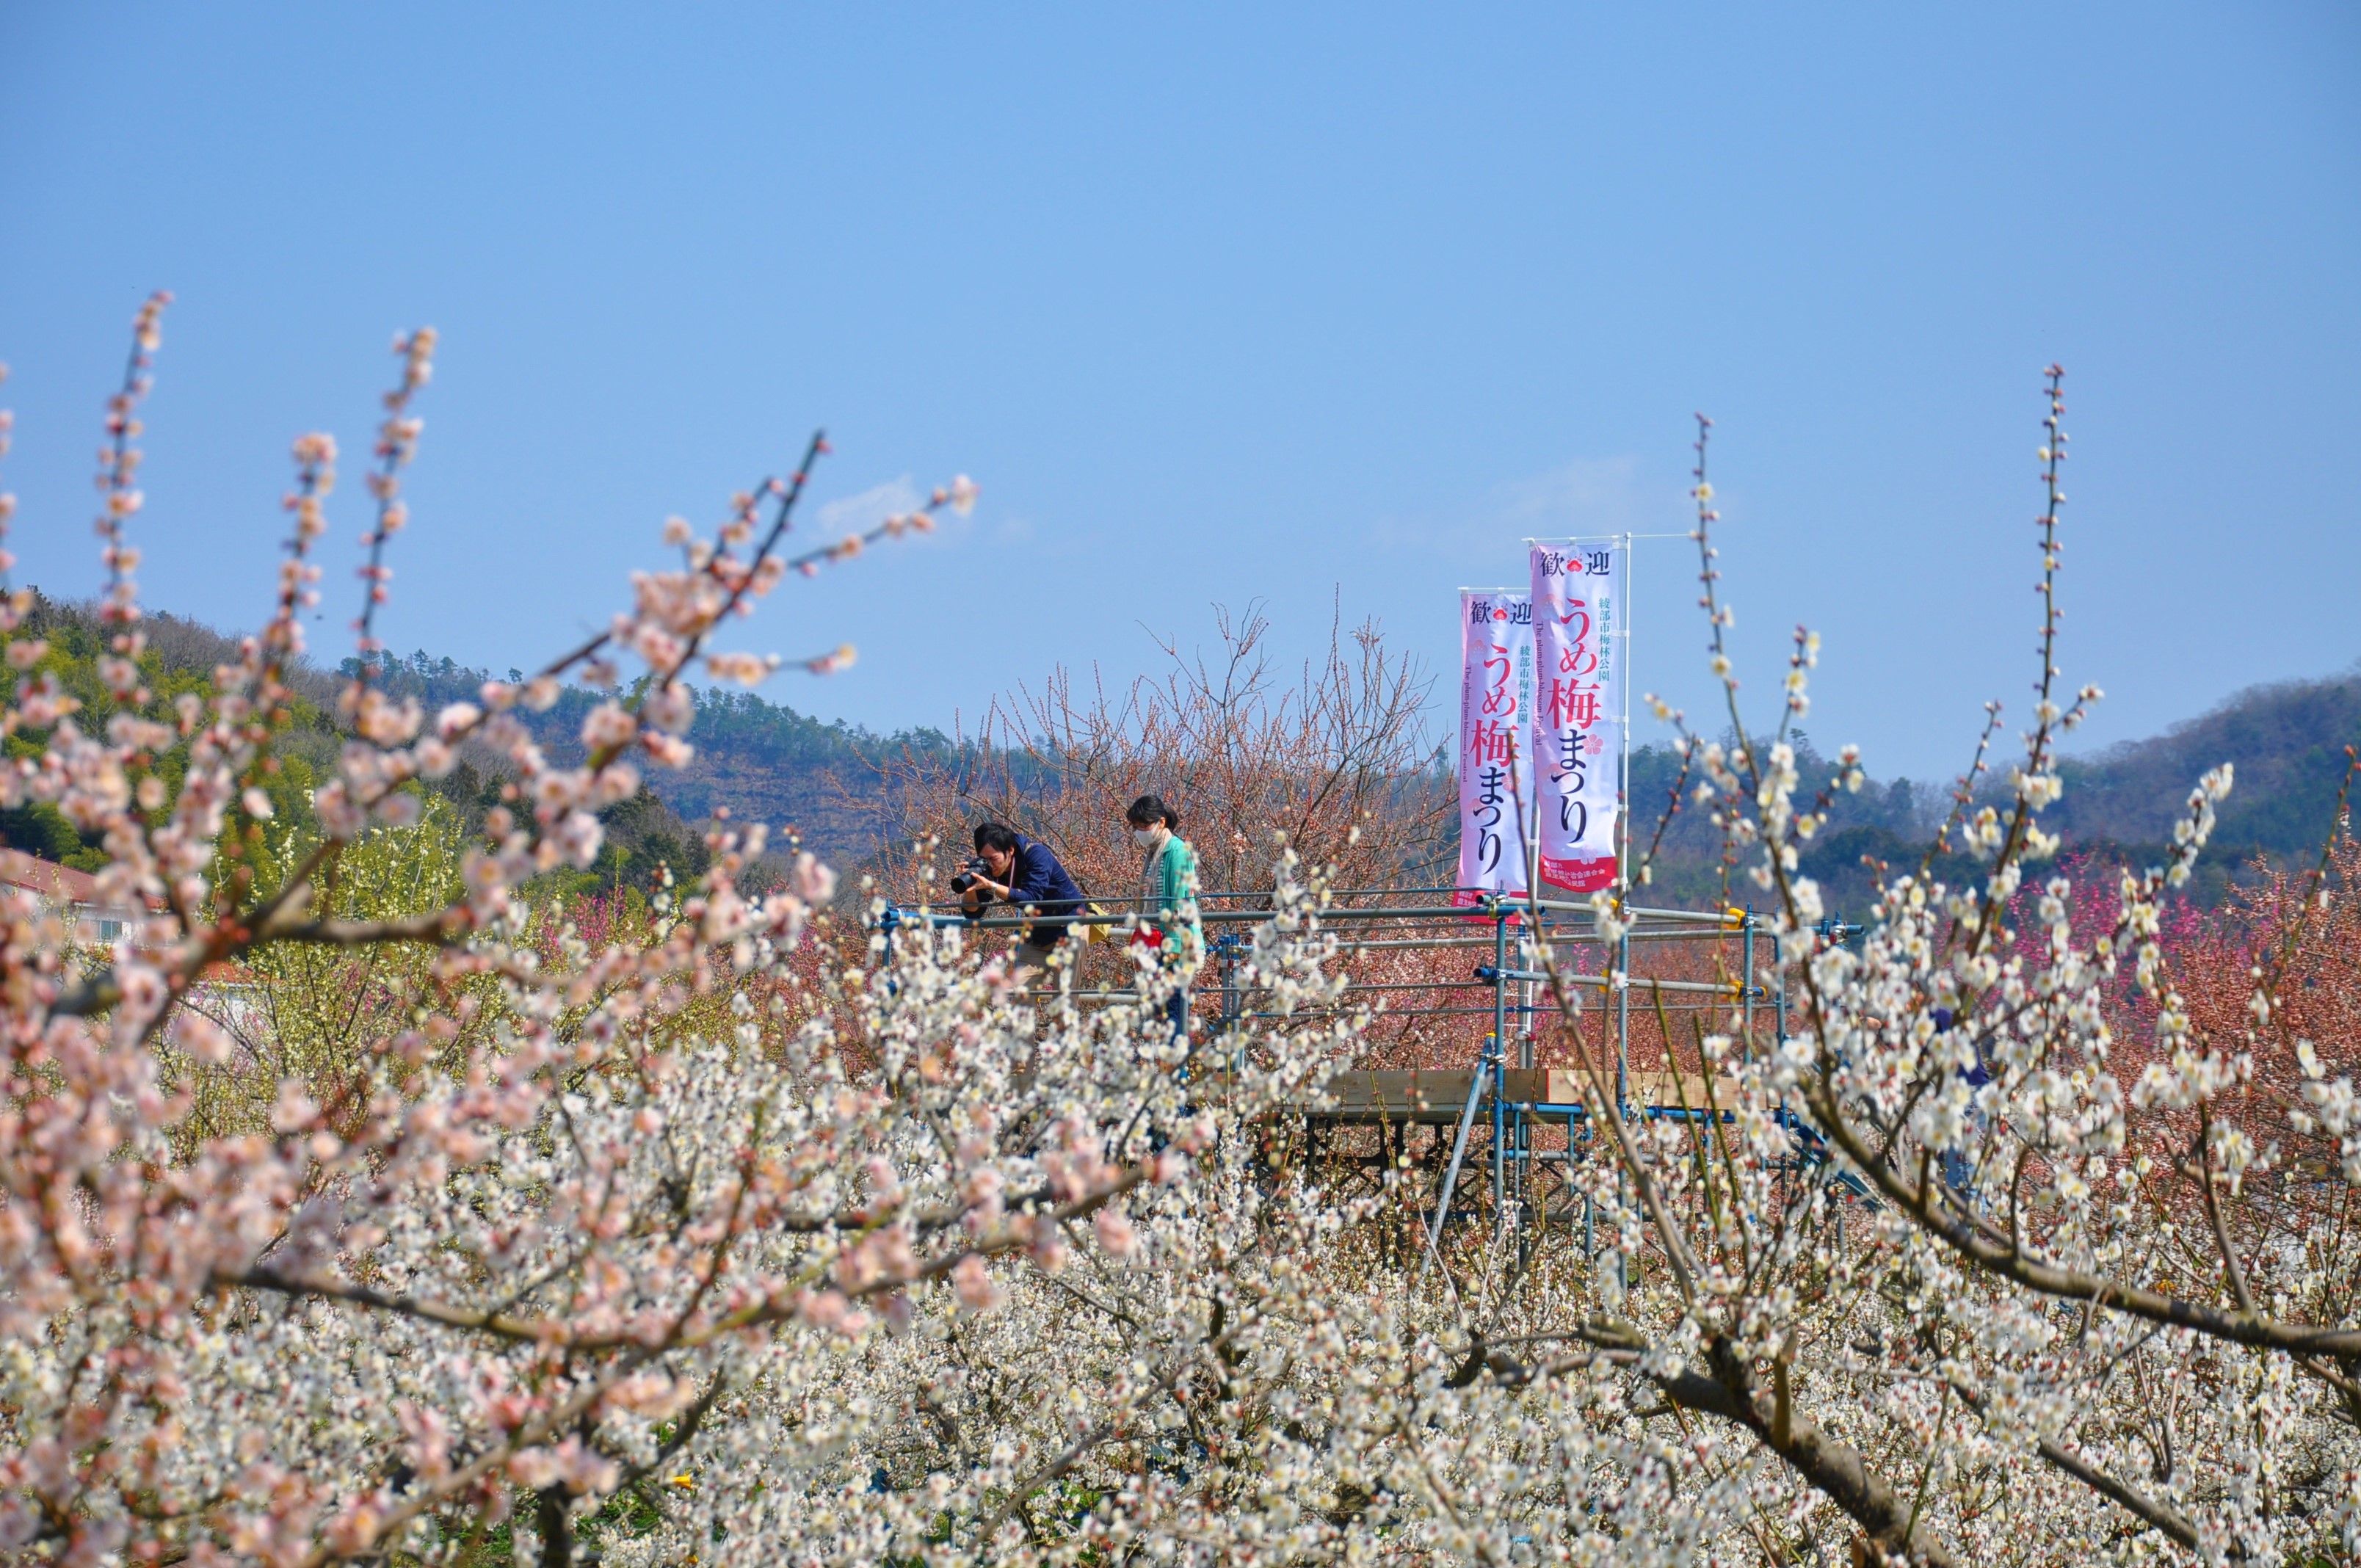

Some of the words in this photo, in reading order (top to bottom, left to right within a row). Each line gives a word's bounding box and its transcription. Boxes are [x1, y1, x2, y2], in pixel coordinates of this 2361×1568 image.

[1598, 598, 1610, 681] 綾部市梅林公園
[1517, 645, 1531, 723] 綾部市梅林公園
